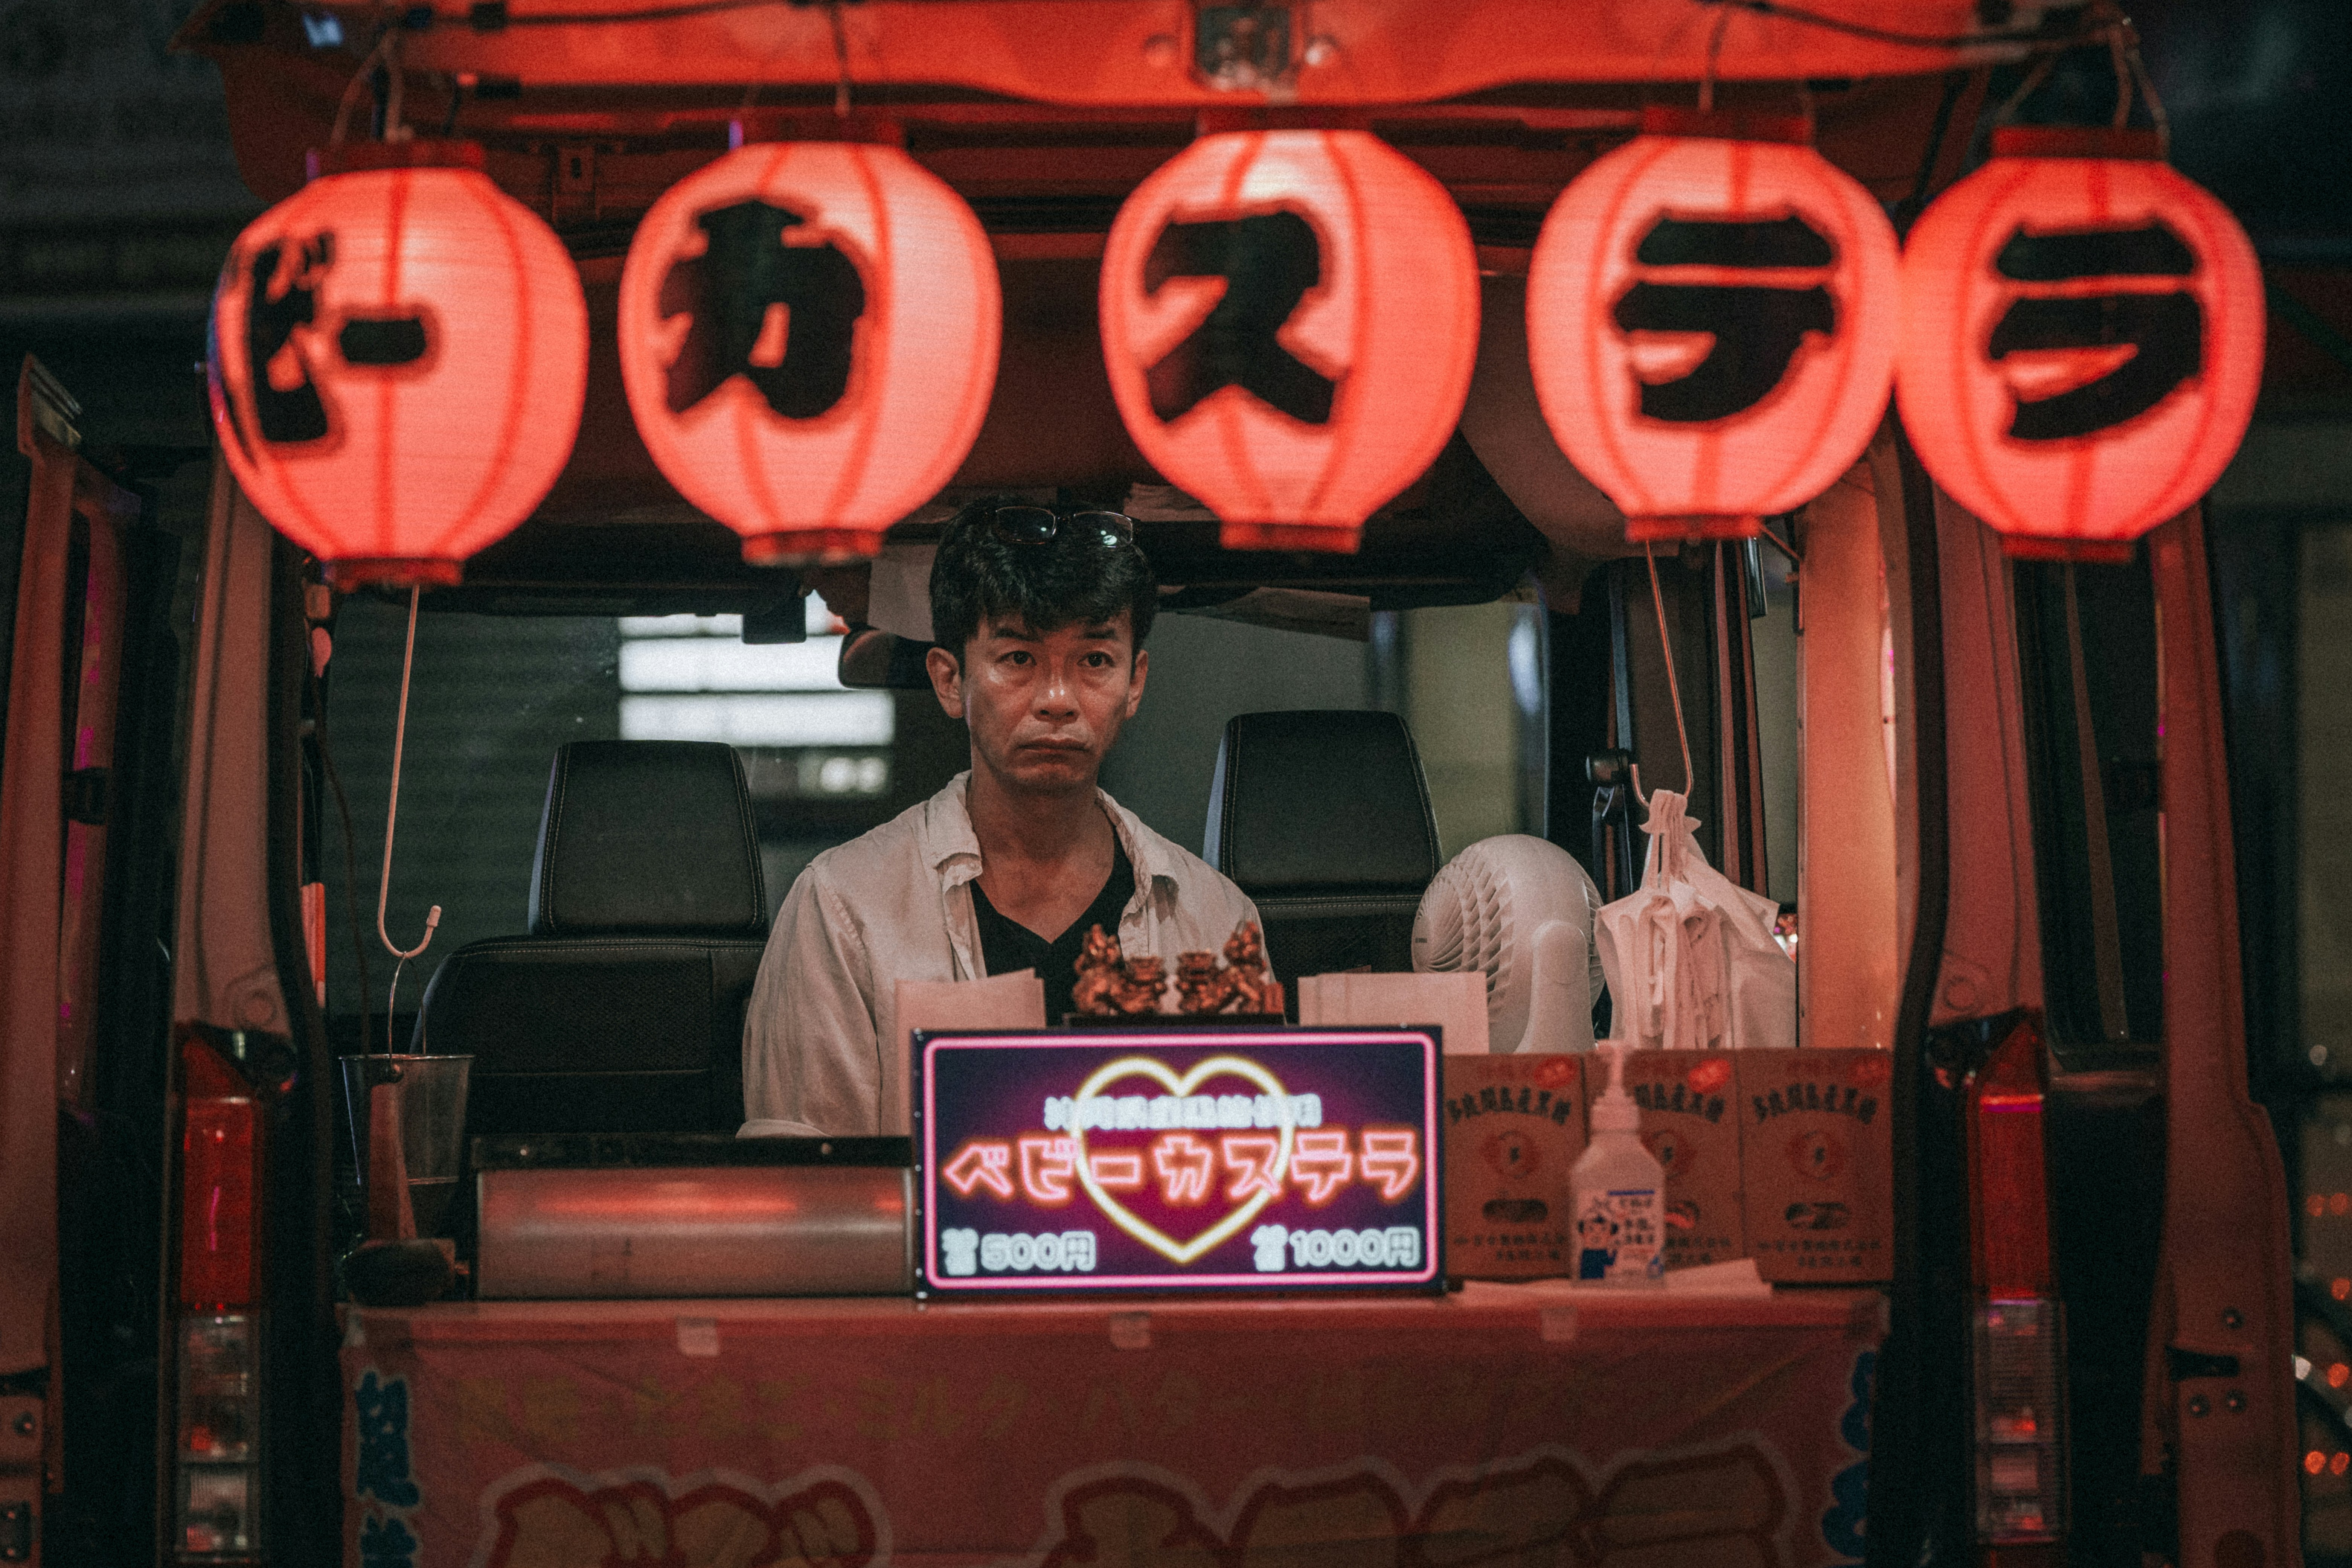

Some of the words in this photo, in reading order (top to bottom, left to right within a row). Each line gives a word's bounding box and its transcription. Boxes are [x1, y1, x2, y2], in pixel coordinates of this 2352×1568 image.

[655, 197, 868, 421] カ
[1141, 206, 1341, 428] ス
[1610, 212, 1838, 425] テ
[1986, 218, 2203, 442] ラ
[942, 1130, 1419, 1202] ベビーカステラ
